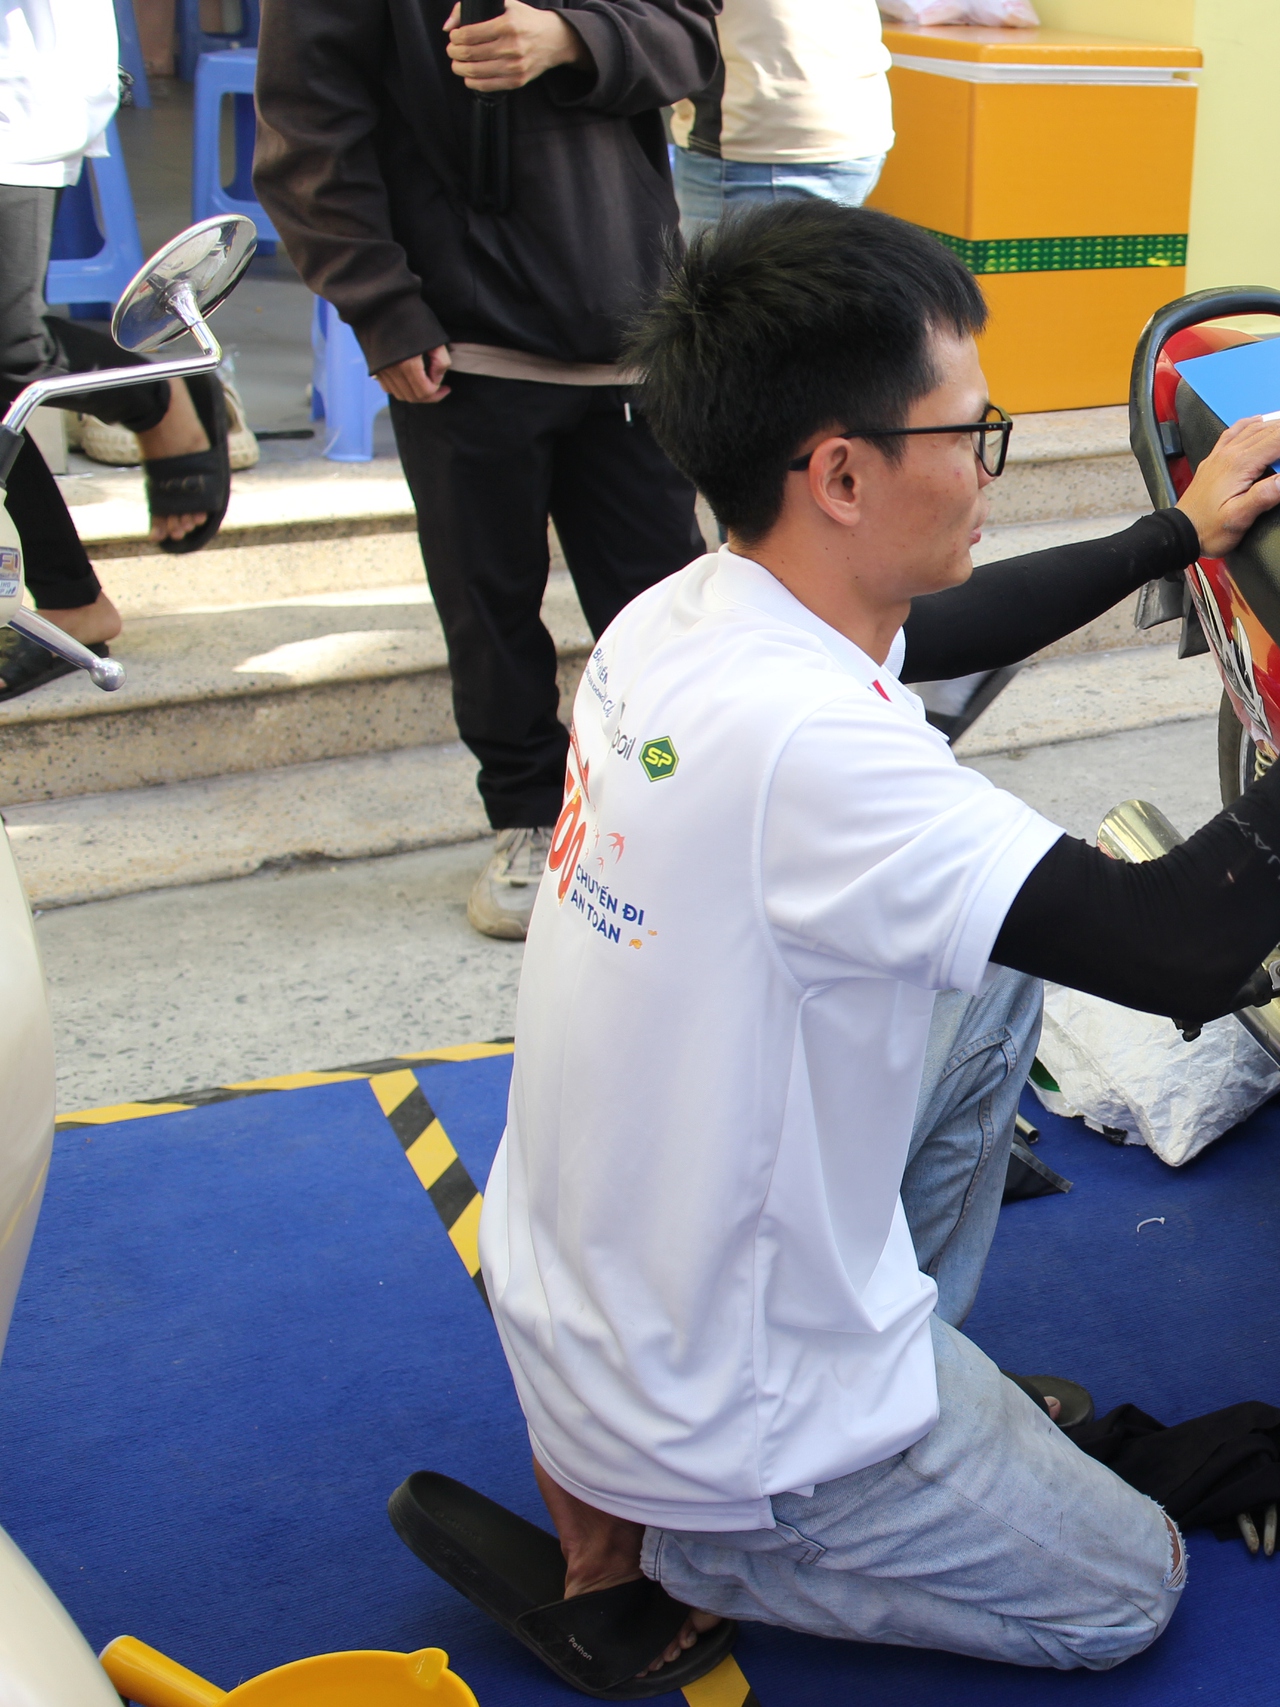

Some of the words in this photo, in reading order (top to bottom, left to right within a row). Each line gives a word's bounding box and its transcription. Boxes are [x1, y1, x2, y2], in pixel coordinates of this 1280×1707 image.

[645, 746, 673, 768] SP
[570, 888, 585, 915] AN
[586, 903, 621, 944] TOÀN
[576, 863, 618, 915] CHUYẾN
[622, 902, 645, 926] ĐI
